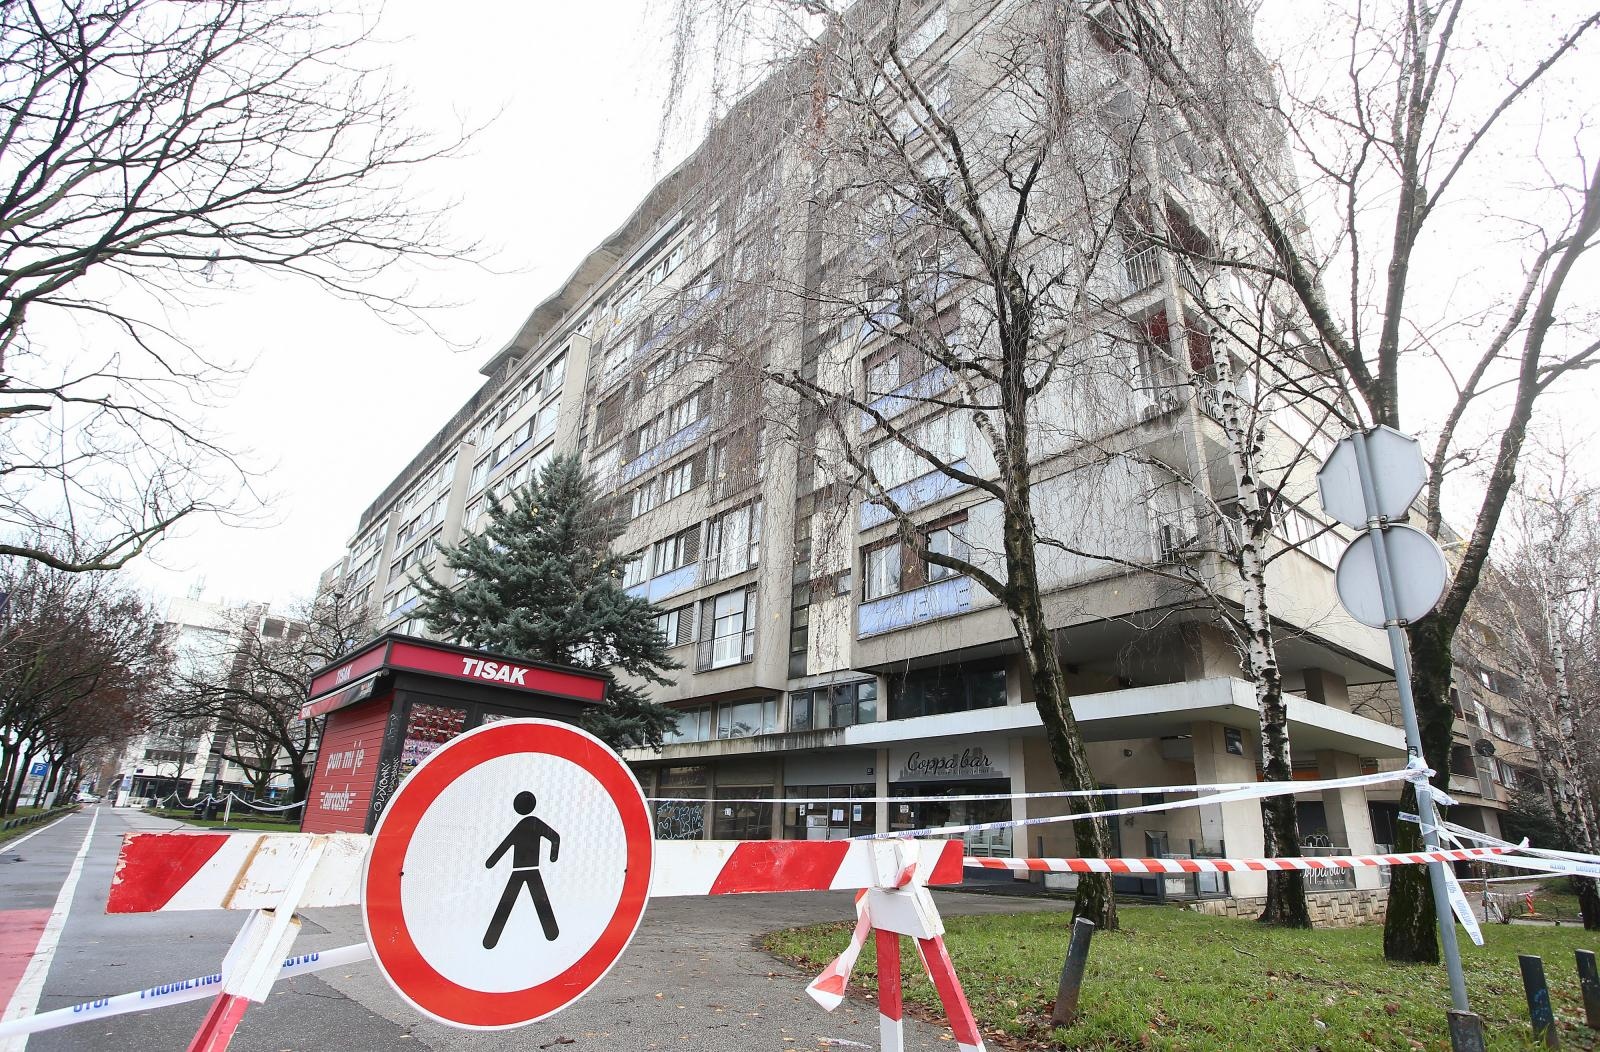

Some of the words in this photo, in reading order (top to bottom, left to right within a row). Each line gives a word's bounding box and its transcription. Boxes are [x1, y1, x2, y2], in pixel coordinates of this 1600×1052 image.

[463, 657, 529, 685] TISAK
[907, 751, 957, 775] Coppa
[960, 748, 992, 768] bar
